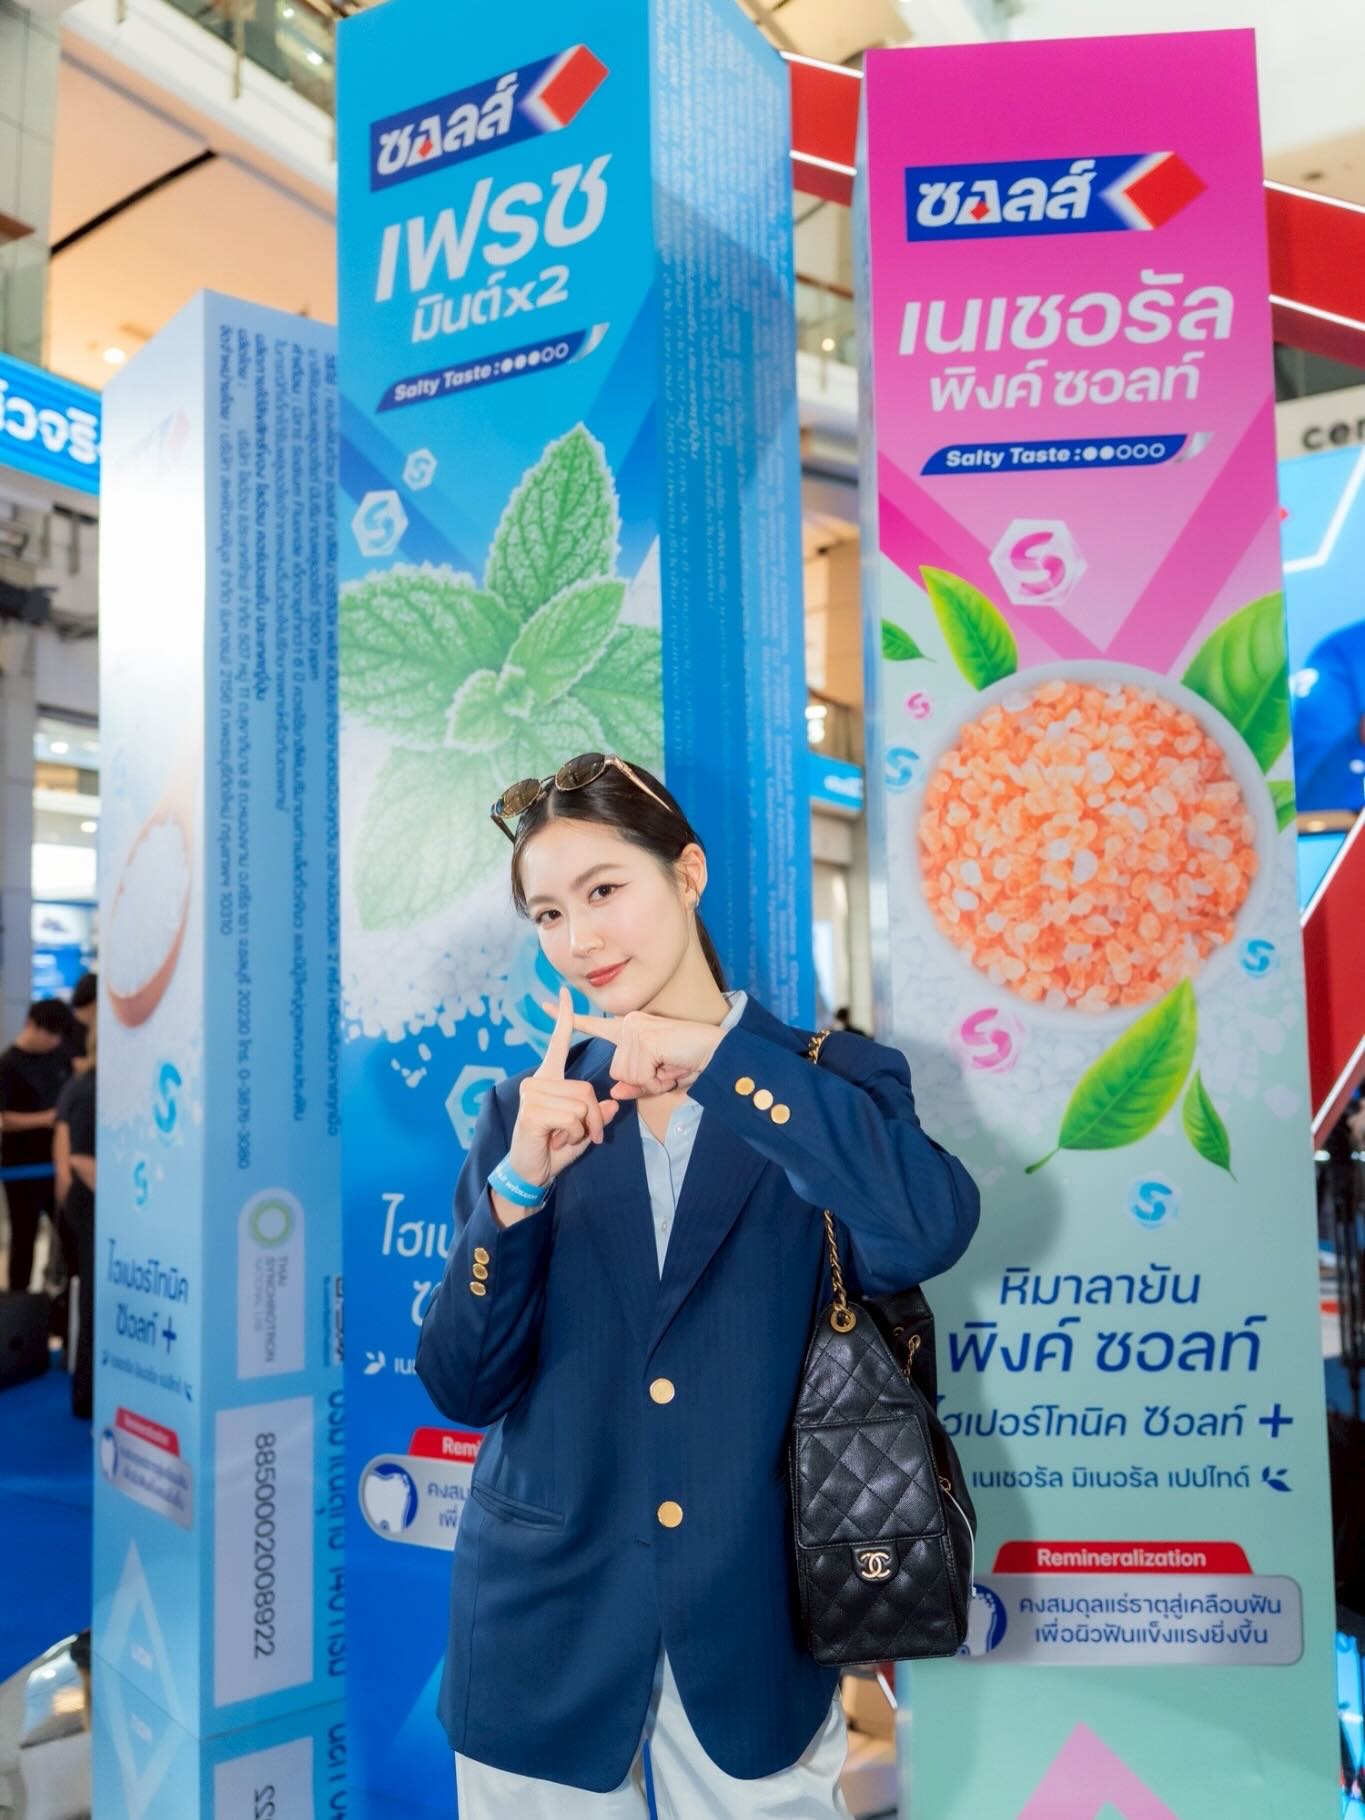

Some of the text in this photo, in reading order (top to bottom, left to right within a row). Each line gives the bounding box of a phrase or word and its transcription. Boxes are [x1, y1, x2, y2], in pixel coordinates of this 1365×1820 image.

[377, 72, 518, 175] ซอลส์
[916, 159, 1097, 227] ซอลส์
[375, 153, 612, 302] เฟรช
[411, 265, 570, 343] มินต์x2
[899, 269, 1235, 355] เนเชอรัล
[394, 372, 440, 403] Salty
[930, 352, 1205, 412] พิงค์ ซอลท์
[946, 449, 1004, 469] Salty
[1000, 1264, 1201, 1305] หิมาลายัน
[949, 1315, 1267, 1373] พิงค์ ซอลท์
[1143, 1404, 1247, 1437] ซอลท์
[972, 1465, 1250, 1489] เนเชอรัล มิเนอรัล เปปไทด์
[254, 1432, 276, 1659] 8850002008922
[1037, 1548, 1207, 1567] Remineralization
[1019, 1593, 1282, 1620] คงสมดุลแร่ธาตุสู่เคลือบฟัน
[1035, 1618, 1269, 1643] เพื่อผิวฟันแข็งแรงยิ่งขึ้น
